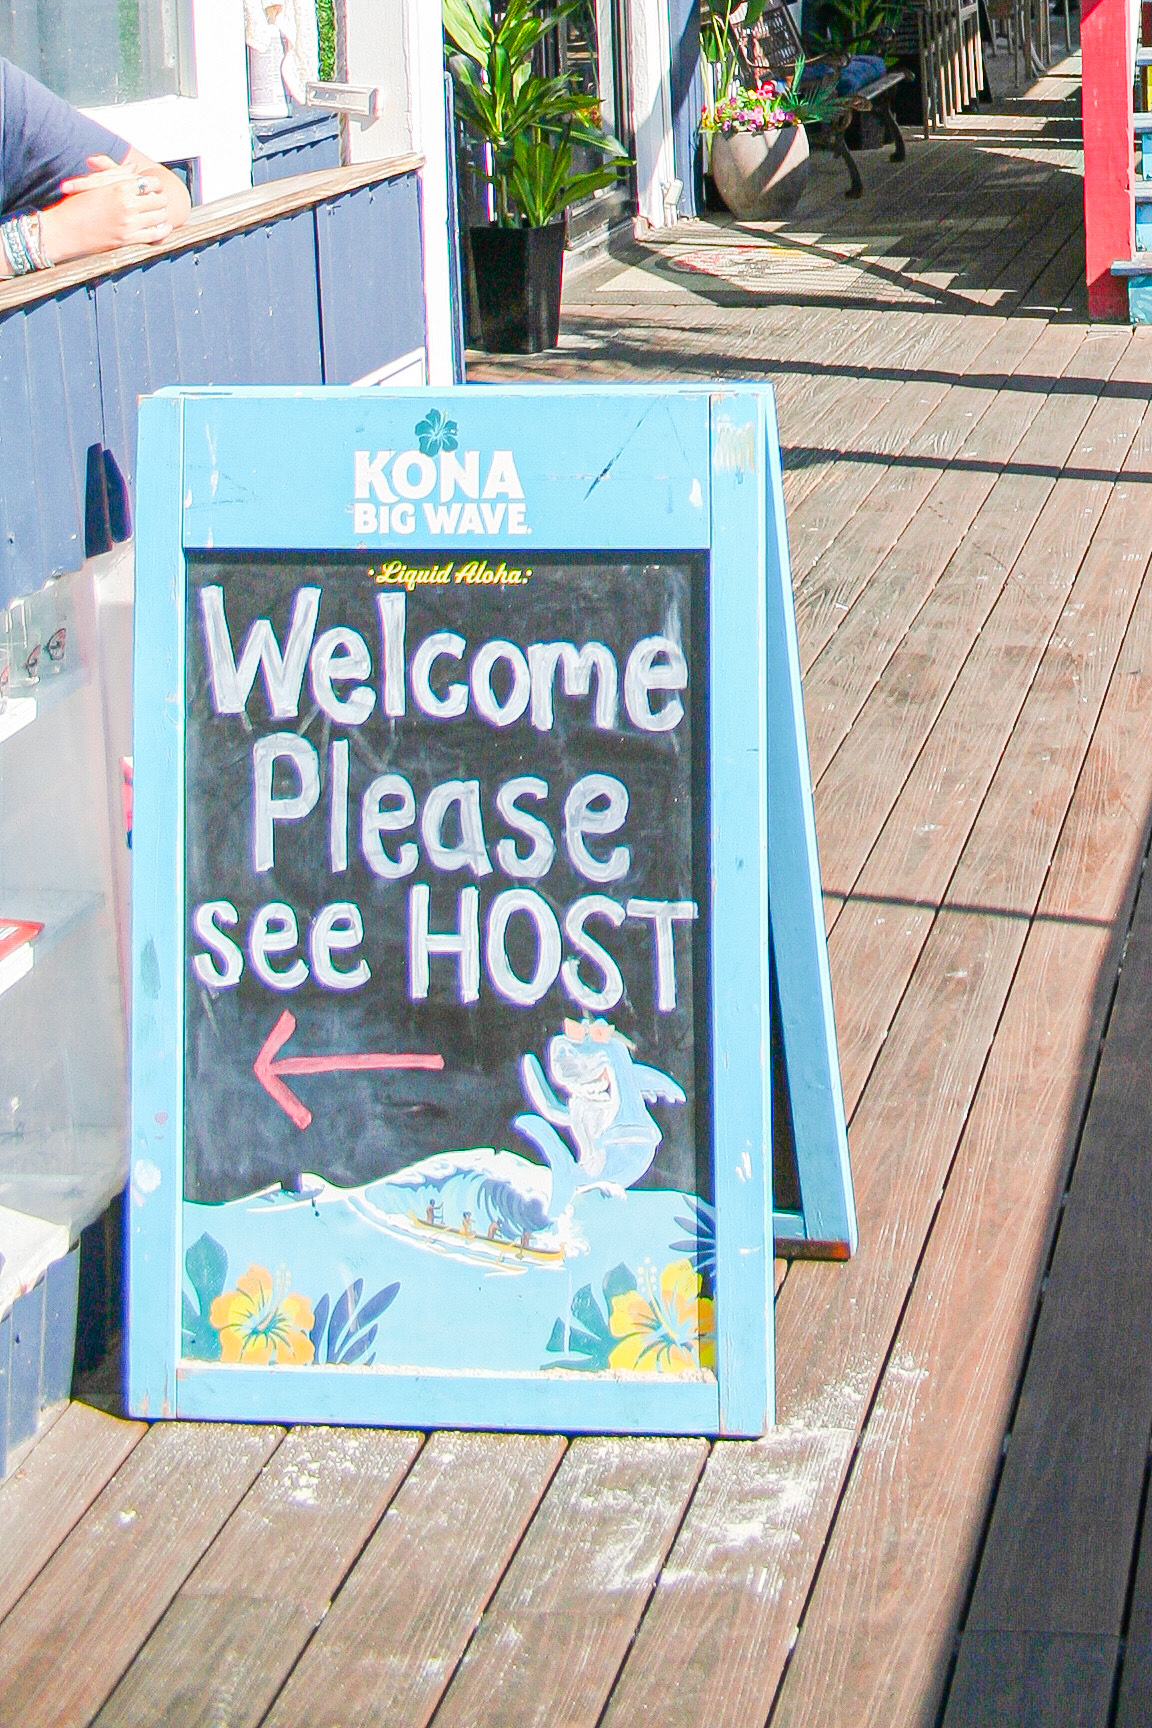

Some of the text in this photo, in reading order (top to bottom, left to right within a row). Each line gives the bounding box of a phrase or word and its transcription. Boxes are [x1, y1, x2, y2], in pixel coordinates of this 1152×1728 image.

[353, 450, 526, 503] KONA
[353, 502, 530, 535] BIG WAVE
[375, 562, 453, 591] Liquid
[200, 585, 690, 732] Welcome
[253, 732, 631, 882] Please
[194, 884, 699, 1013] see HOST
